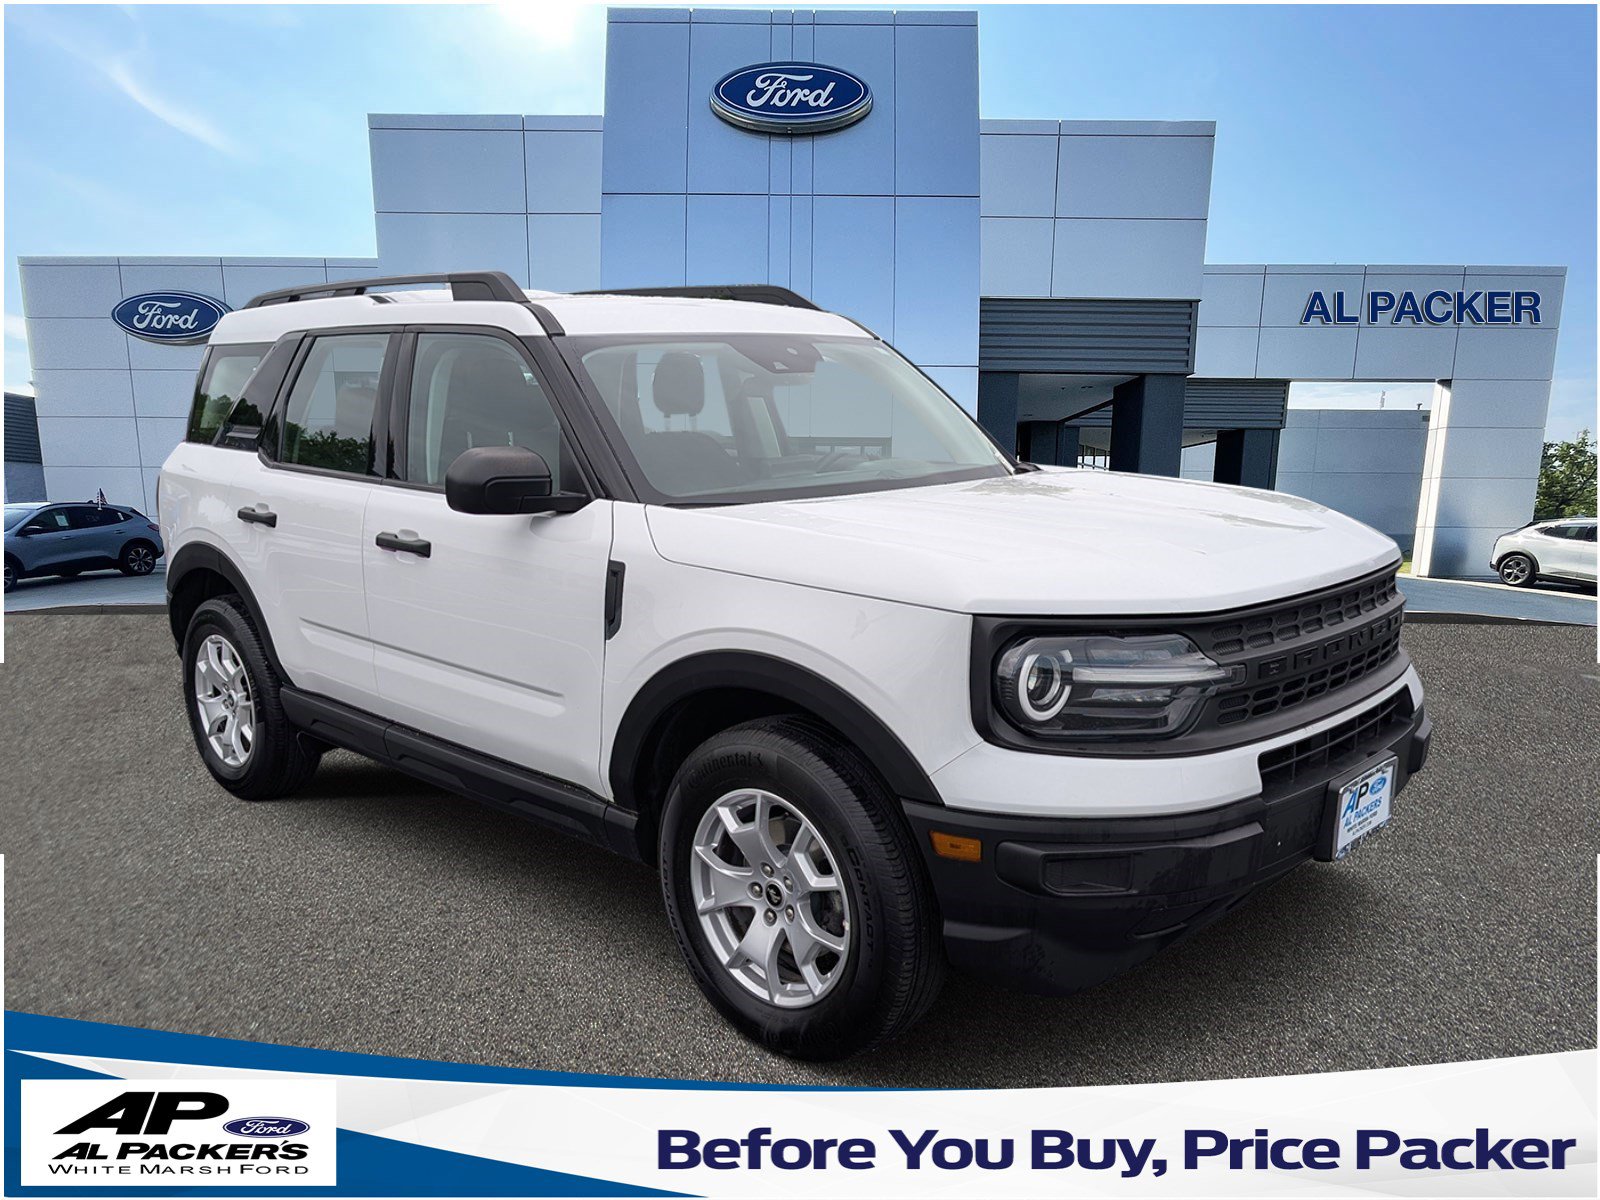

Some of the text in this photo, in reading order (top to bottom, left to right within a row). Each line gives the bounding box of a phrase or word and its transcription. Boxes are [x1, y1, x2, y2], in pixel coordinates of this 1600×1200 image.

[746, 73, 836, 107] Ford
[133, 301, 199, 329] Ford
[1301, 290, 1543, 325] AL PACKER
[1342, 781, 1370, 820] AP
